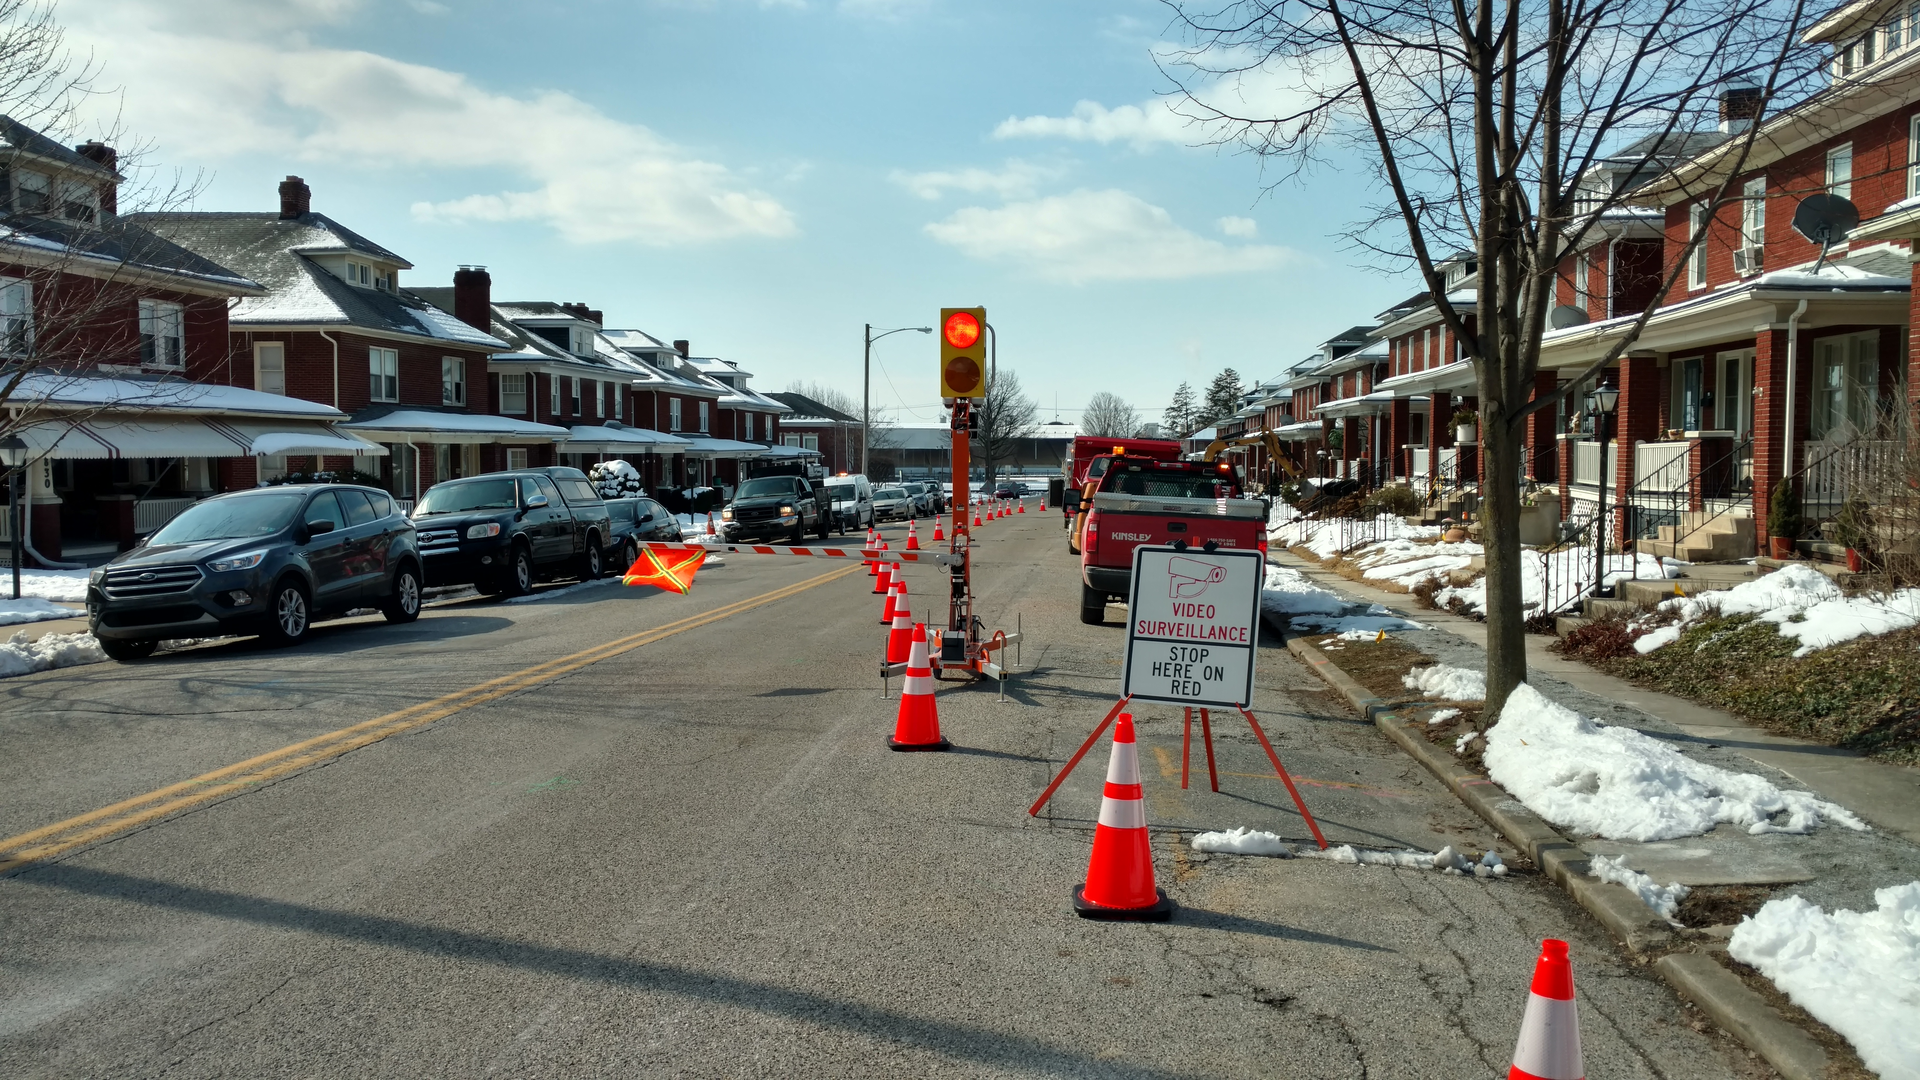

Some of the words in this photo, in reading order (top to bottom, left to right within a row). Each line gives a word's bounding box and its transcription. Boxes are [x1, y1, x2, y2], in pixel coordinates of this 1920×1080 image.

[1111, 532, 1152, 542] KINSLEY
[1172, 602, 1215, 619] VIDEO
[1137, 620, 1248, 642] SURVEILLANCE
[1169, 646, 1209, 663] STOP
[1152, 661, 1193, 679] HERE
[1203, 665, 1224, 682] ON
[1171, 679, 1201, 697] RED
